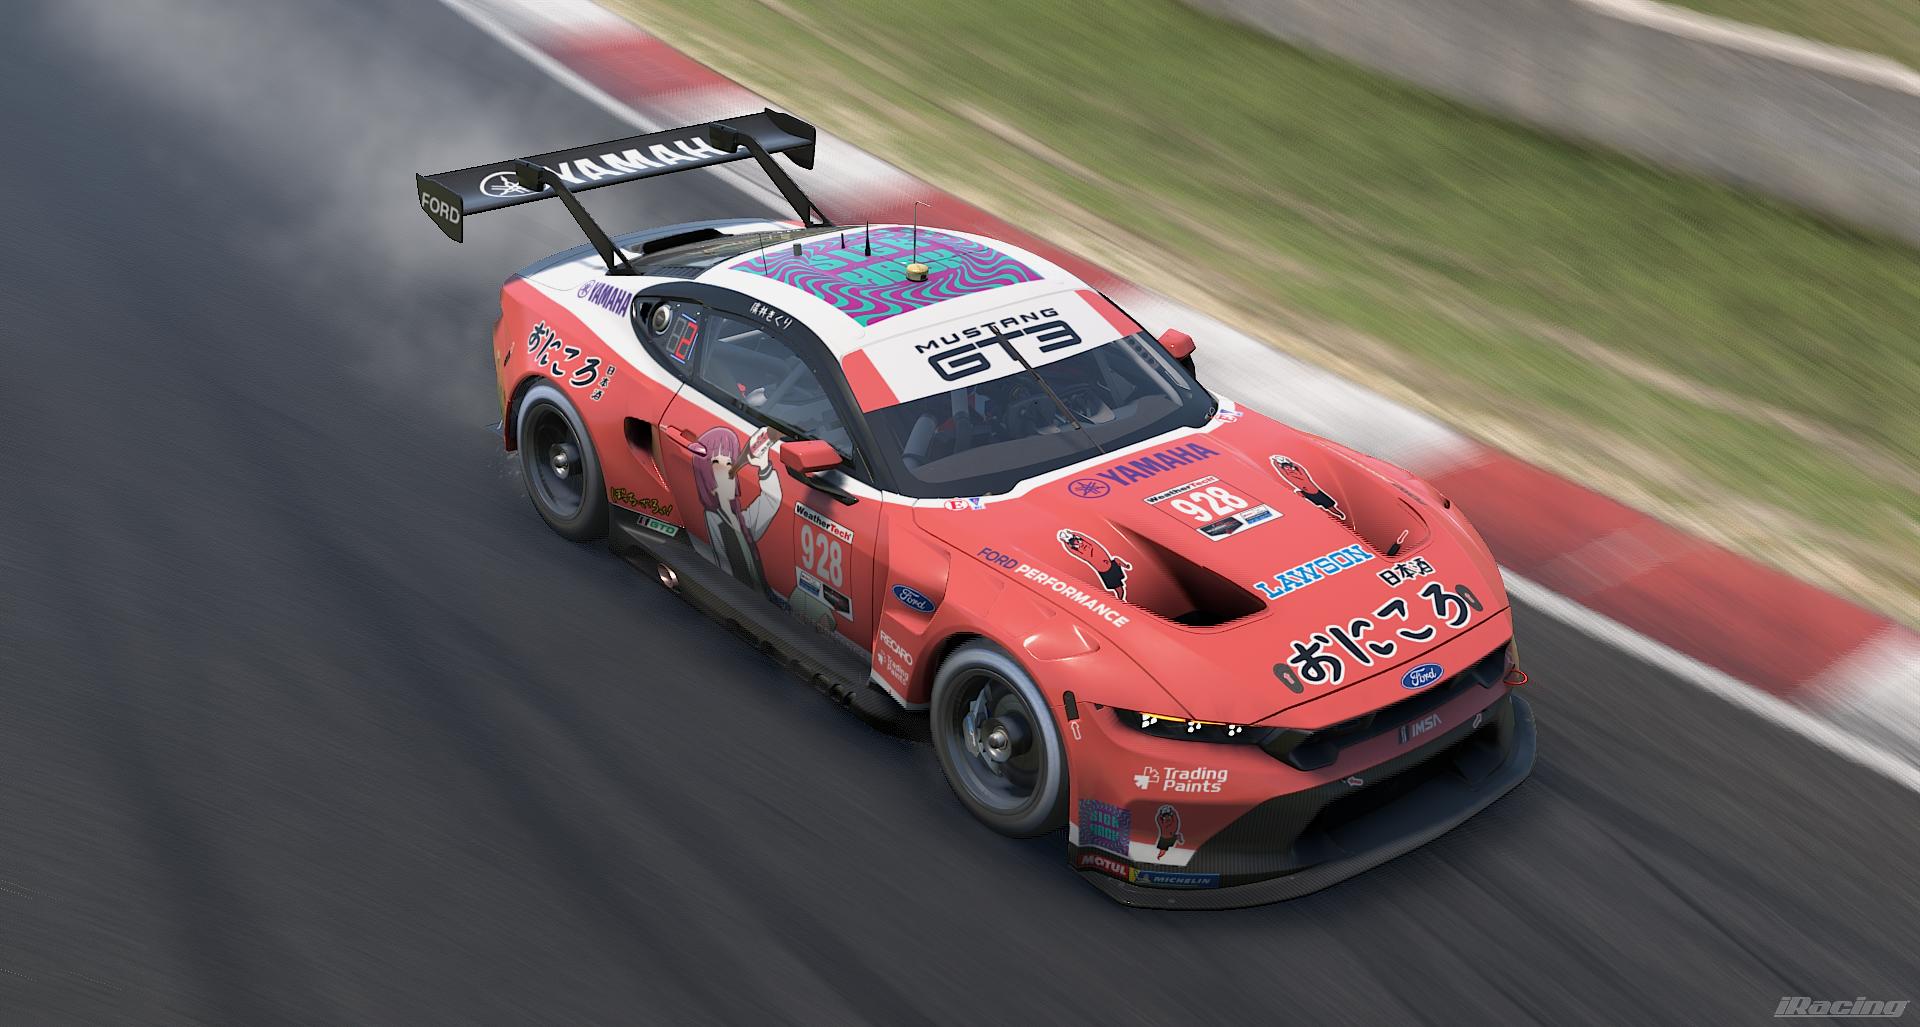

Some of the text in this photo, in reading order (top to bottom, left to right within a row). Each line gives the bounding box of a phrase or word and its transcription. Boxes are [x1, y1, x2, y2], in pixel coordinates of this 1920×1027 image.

[545, 136, 747, 185] YAMAH
[421, 191, 461, 225] FORD
[588, 281, 633, 318] YAMAHA
[914, 307, 1060, 354] MUSTANG
[527, 321, 602, 388] おにころ
[927, 319, 1082, 382] GT3
[1096, 442, 1220, 487] YAMAHA
[1147, 475, 1216, 504] WeatherTech
[1170, 486, 1249, 523] 928
[649, 520, 676, 534] GTD
[796, 504, 851, 541] WeatherTech
[801, 524, 843, 588] 928
[1255, 544, 1374, 599] LAWSON
[1377, 557, 1434, 587] 日本酒
[899, 588, 926, 610] Ford
[976, 547, 1130, 628] FORD PERFORMANCE
[880, 630, 913, 667] RECARO
[1289, 583, 1469, 683] おにころ
[1410, 667, 1437, 687] Ford
[1411, 713, 1443, 738] IMSA
[1163, 767, 1228, 783] Trading
[1163, 780, 1222, 793] Paints
[1081, 855, 1128, 876] MOTUL
[1153, 876, 1211, 885] MICHELIN
